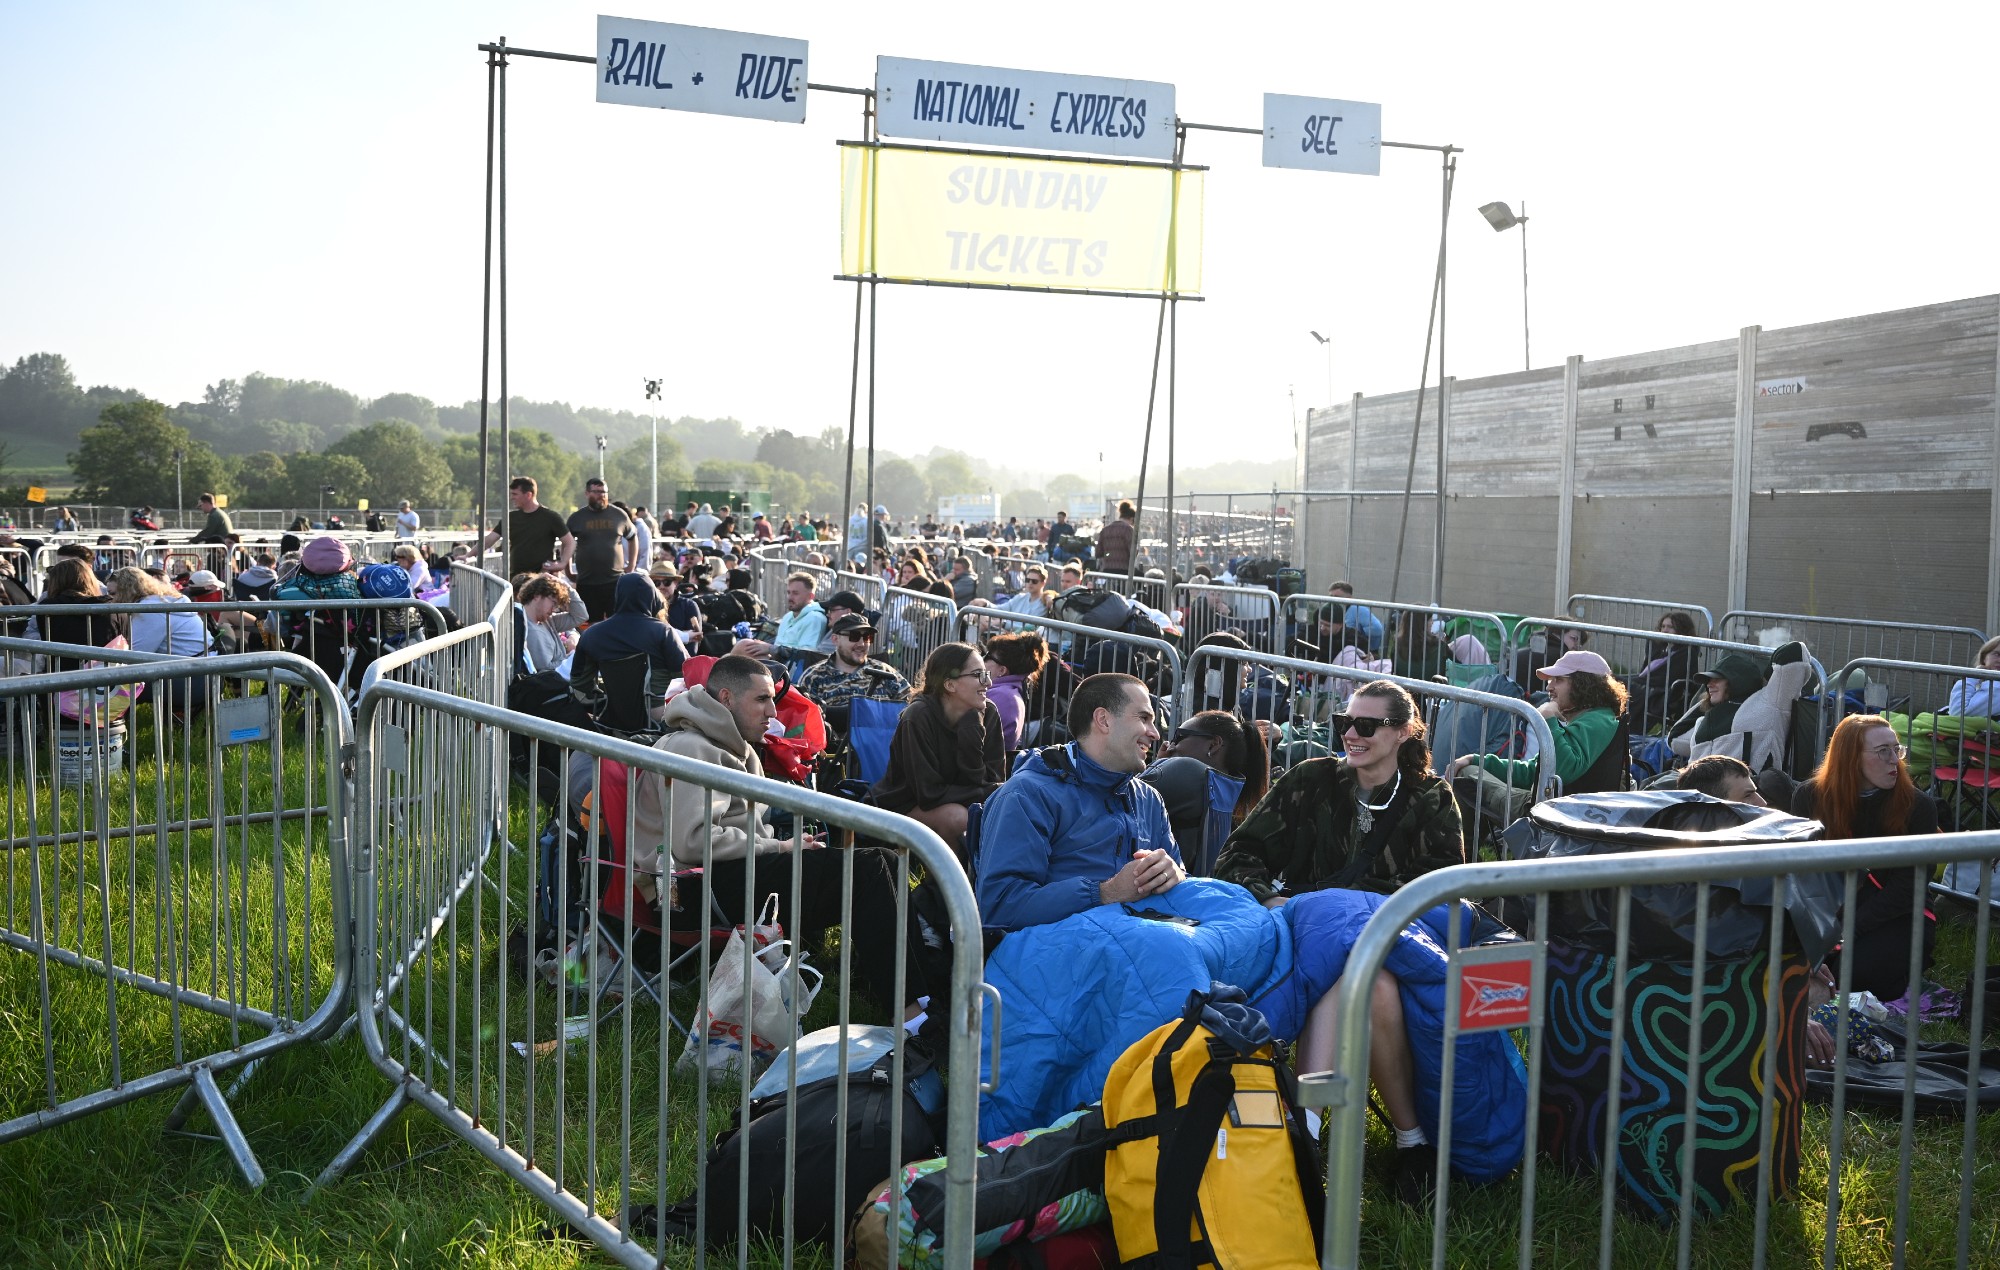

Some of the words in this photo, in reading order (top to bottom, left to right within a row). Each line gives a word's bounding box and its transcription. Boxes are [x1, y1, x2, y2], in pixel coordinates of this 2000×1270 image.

[605, 37, 673, 90] RAIL
[735, 53, 803, 103] RIDE
[913, 78, 1025, 131] NATIONAL
[1050, 91, 1147, 140] EXPRESS
[1301, 114, 1343, 156] SEE
[946, 165, 1108, 213] SUNDAY
[945, 230, 1108, 278] TICKETS
[1767, 383, 1796, 397] sector
